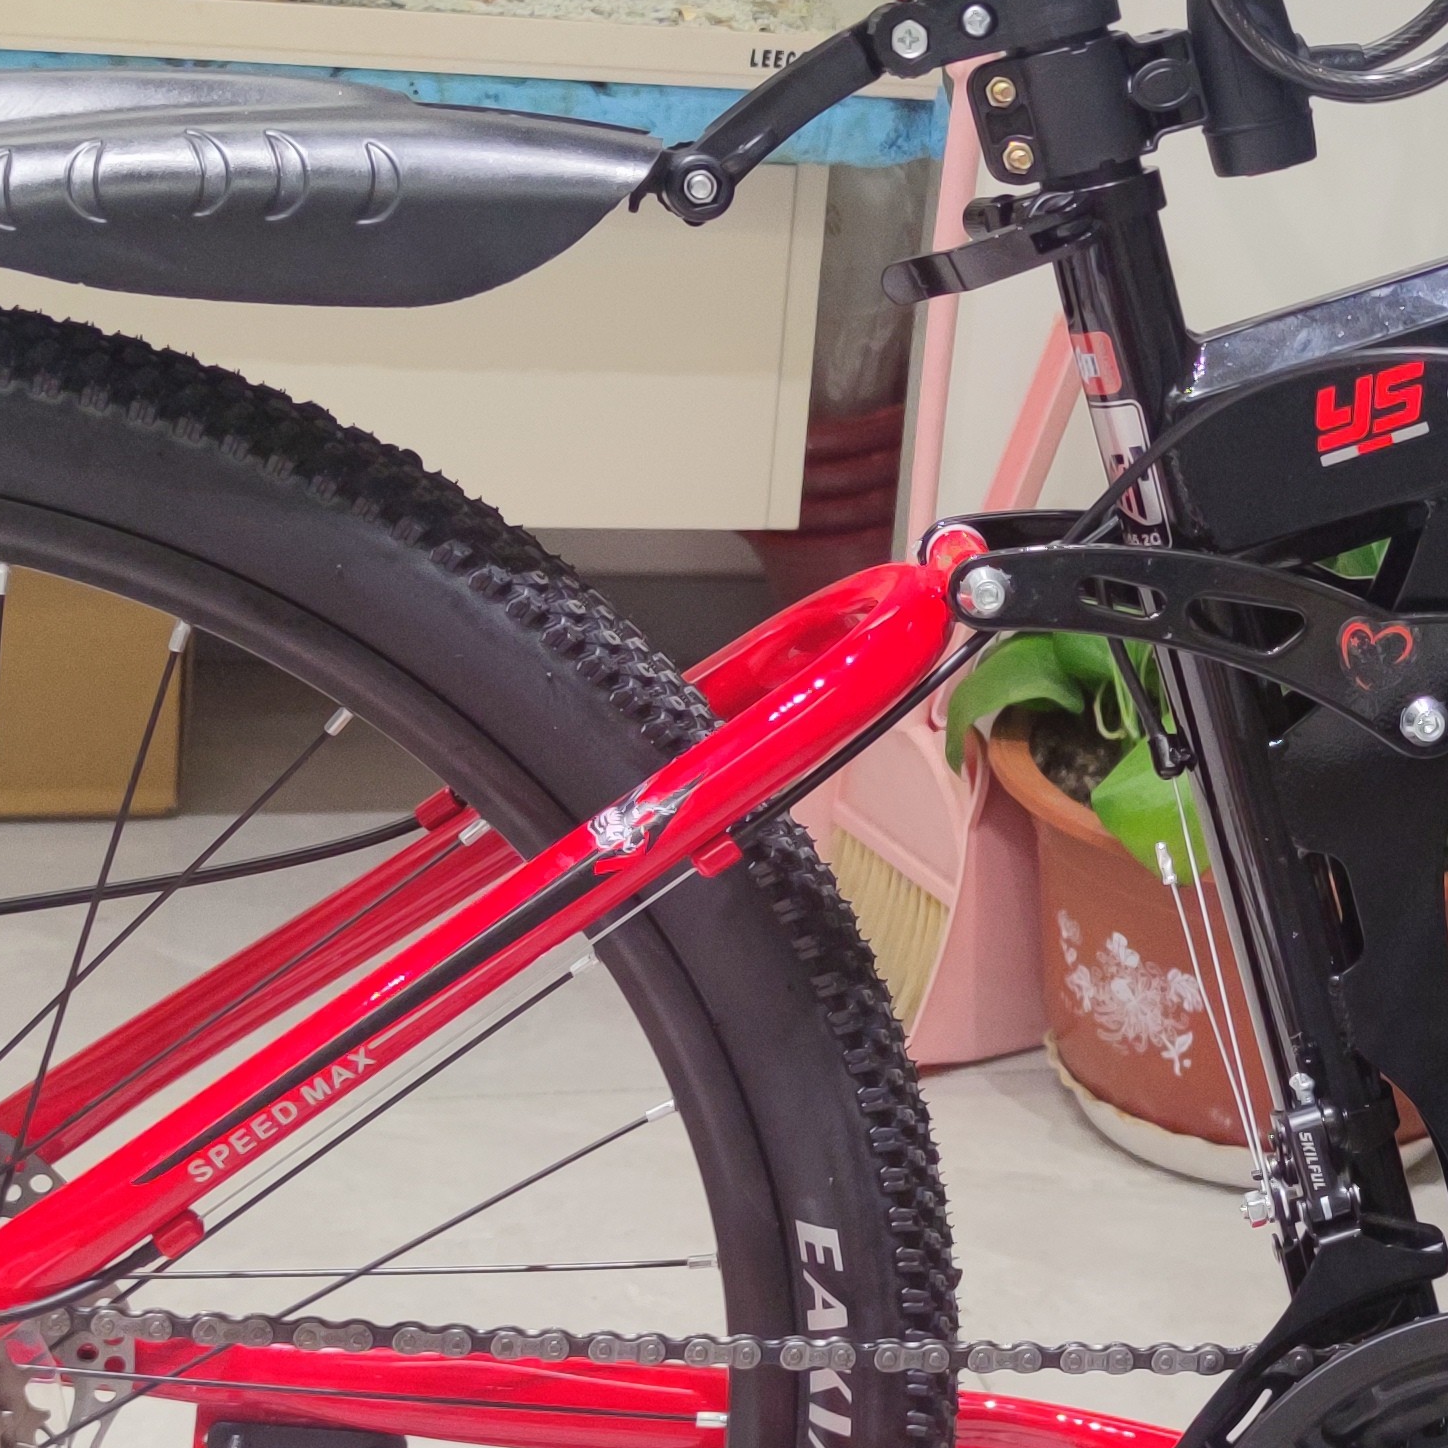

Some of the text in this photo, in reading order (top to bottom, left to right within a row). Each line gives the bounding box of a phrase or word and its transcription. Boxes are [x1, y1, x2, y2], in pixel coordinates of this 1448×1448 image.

[187, 1045, 377, 1183] SPEED MAX
[1298, 1131, 1327, 1191] SKILFUL
